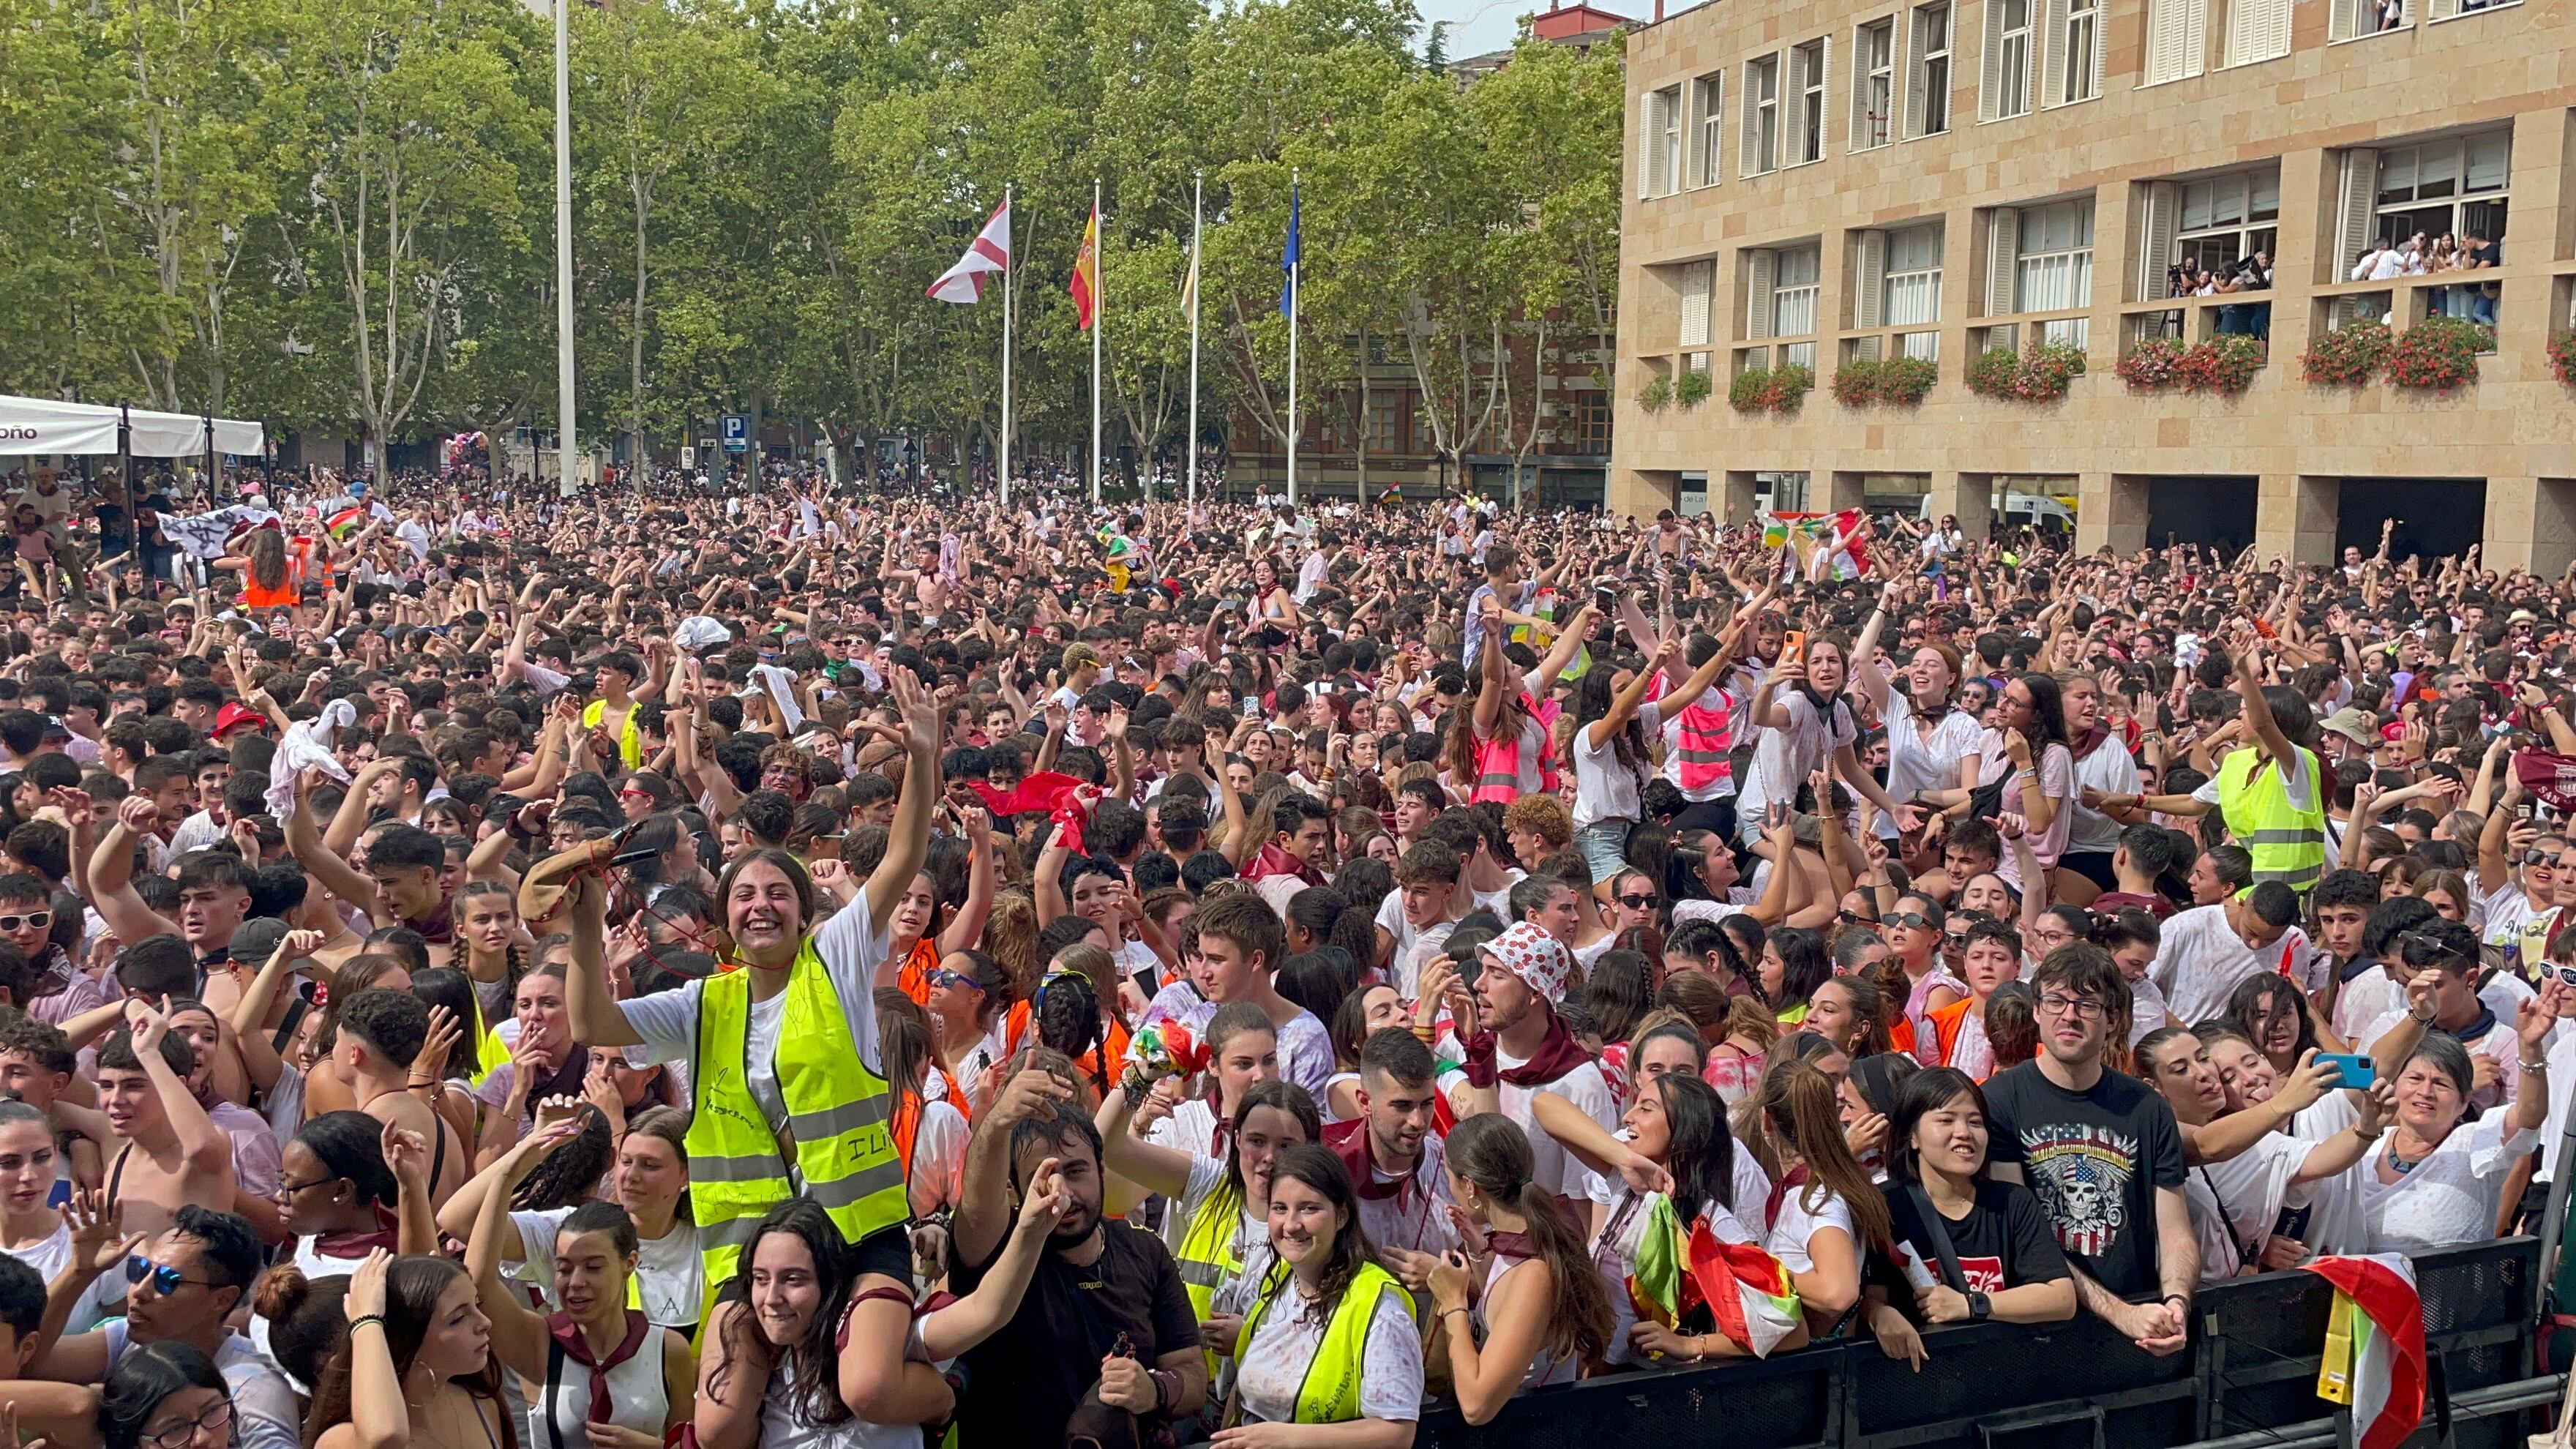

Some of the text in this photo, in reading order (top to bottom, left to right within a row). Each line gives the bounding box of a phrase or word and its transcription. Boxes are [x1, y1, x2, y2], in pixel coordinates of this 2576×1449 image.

[727, 418, 741, 437] P
[1684, 495, 1693, 503] de
[2537, 785, 2560, 804] SAN
